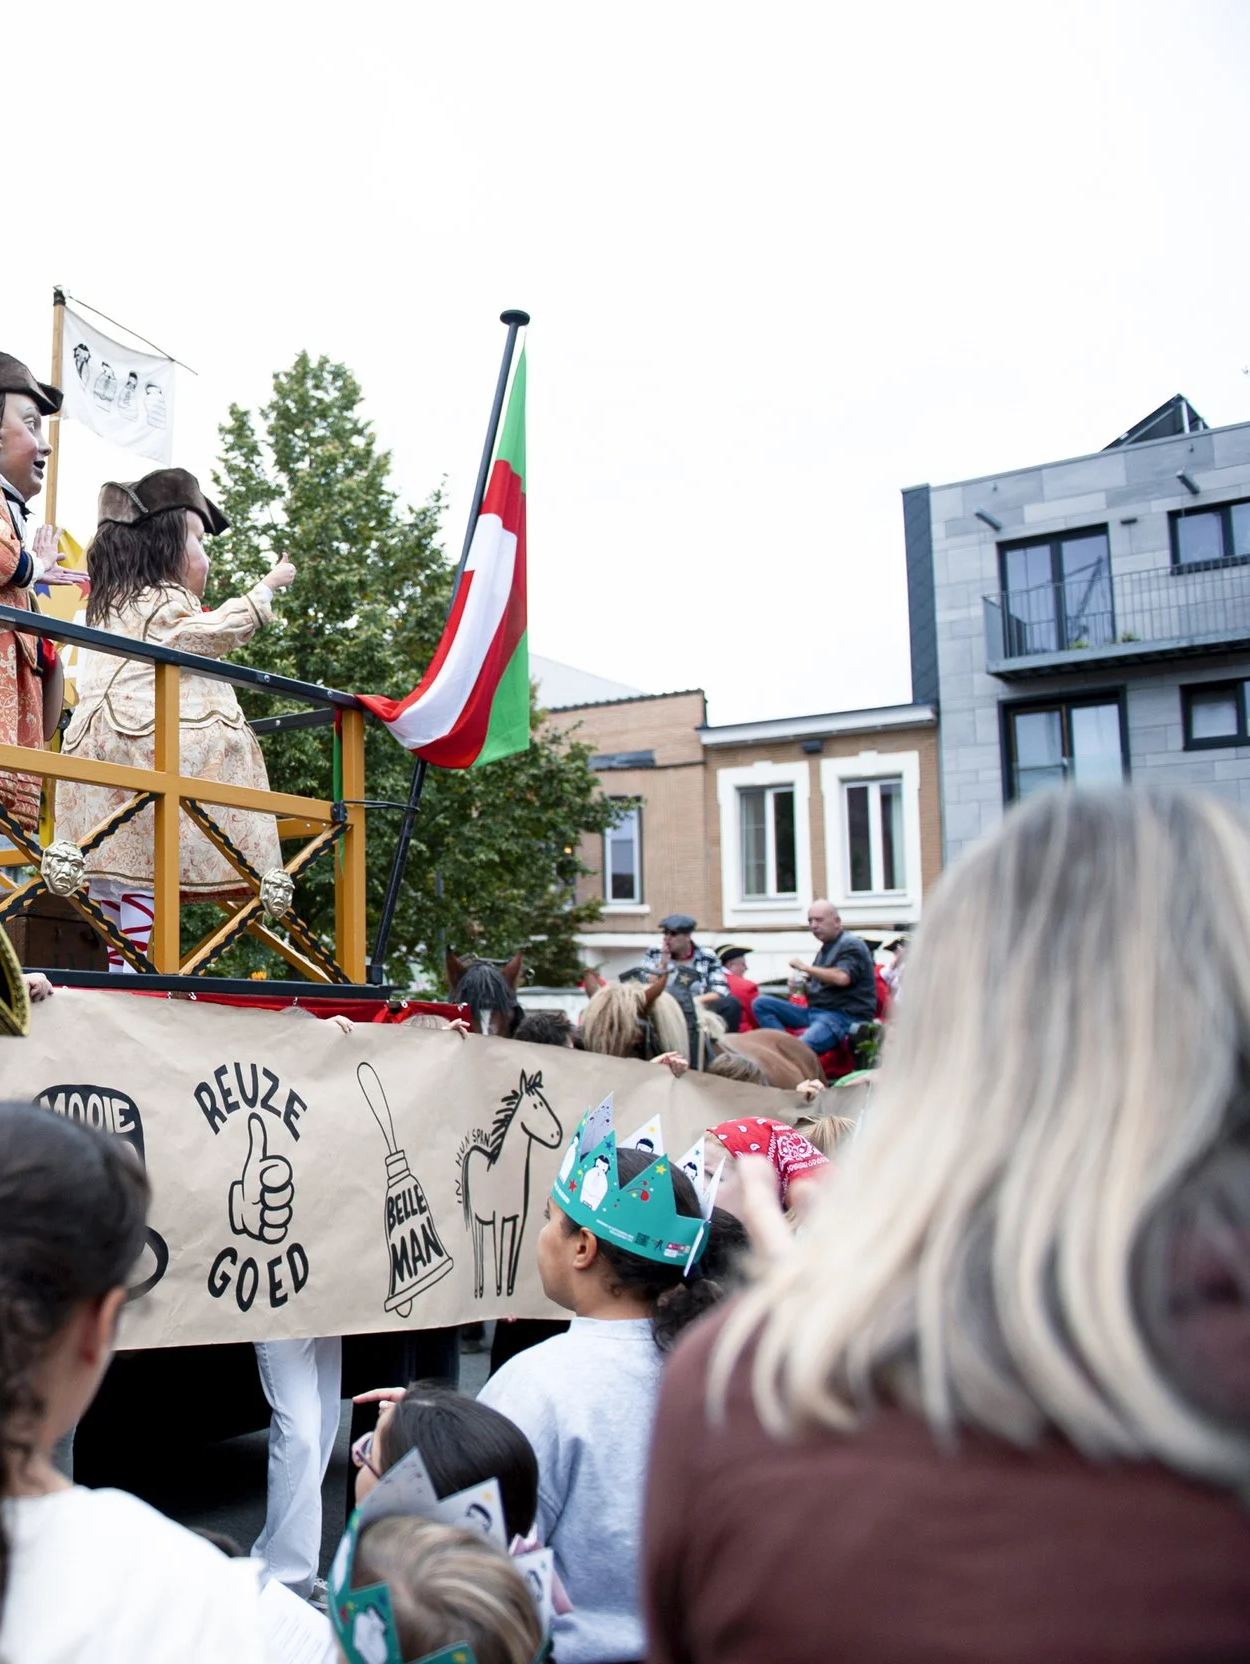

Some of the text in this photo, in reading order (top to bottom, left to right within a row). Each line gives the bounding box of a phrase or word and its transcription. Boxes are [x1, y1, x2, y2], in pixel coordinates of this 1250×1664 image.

[193, 1062, 308, 1141] REUZE
[386, 1184, 427, 1235] BELLE
[207, 1242, 309, 1312] GOED
[390, 1217, 444, 1295] MAN
